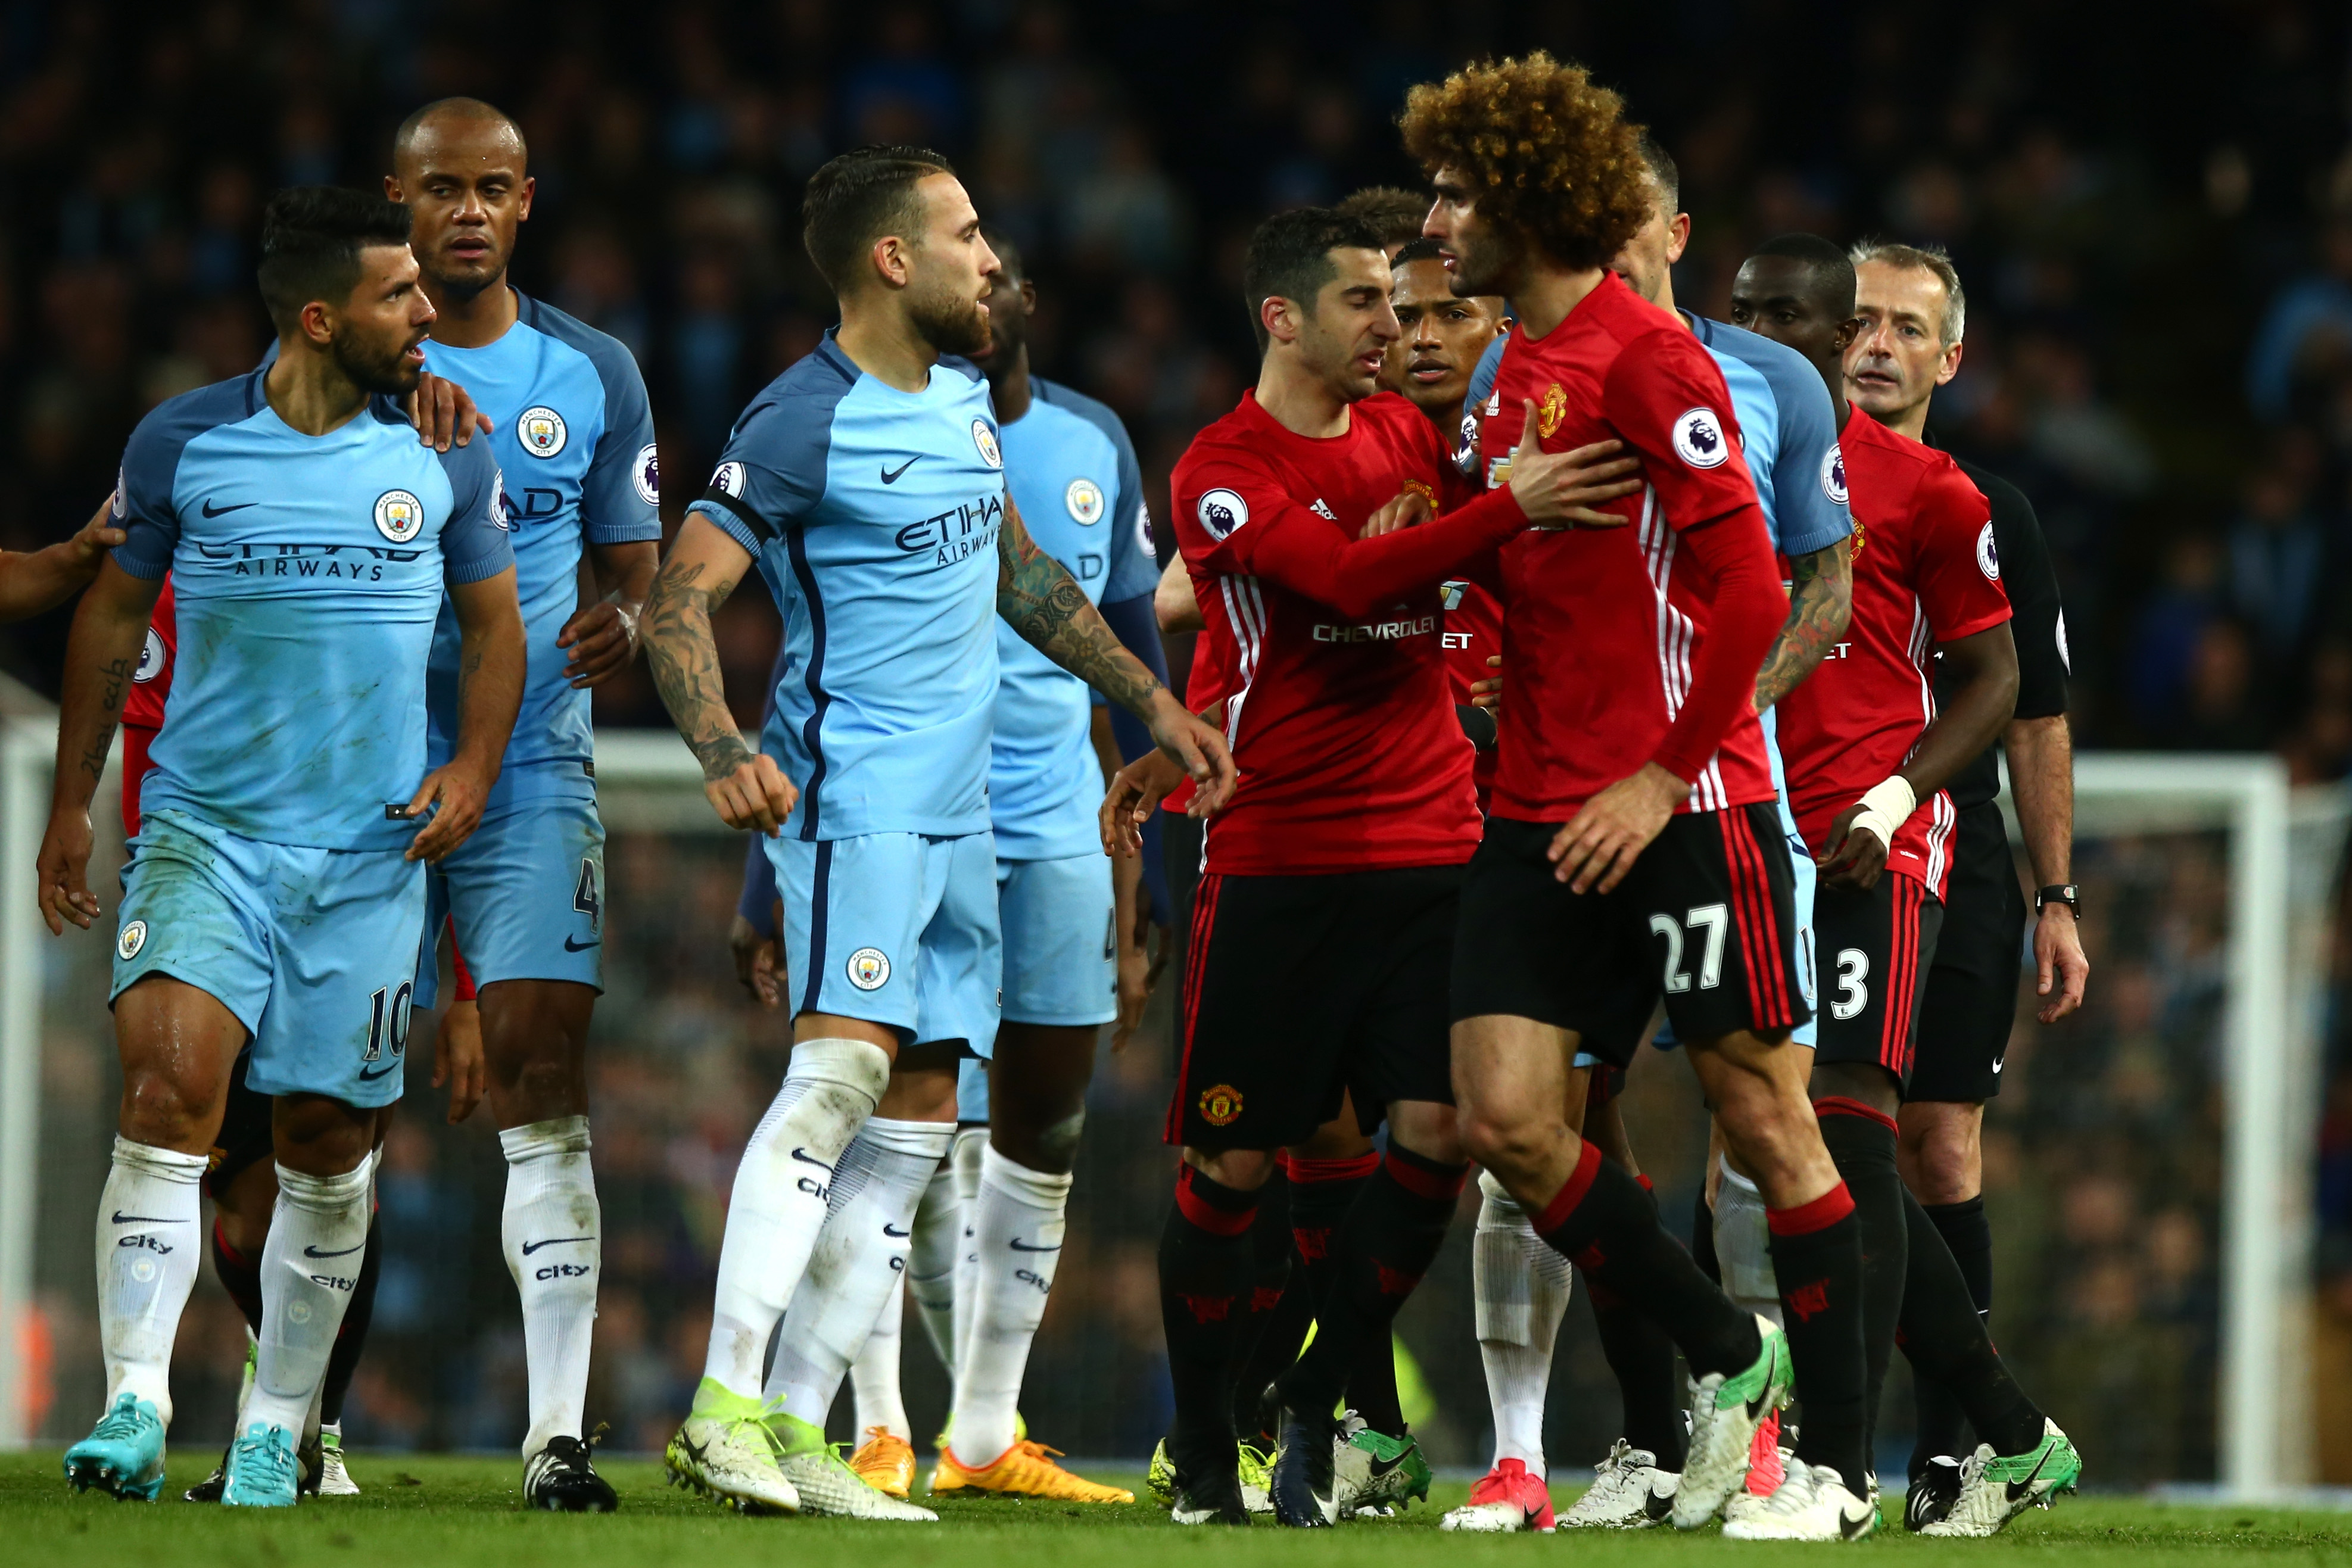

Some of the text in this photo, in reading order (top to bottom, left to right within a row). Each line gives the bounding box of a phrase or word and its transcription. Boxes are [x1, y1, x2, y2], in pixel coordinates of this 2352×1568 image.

[522, 410, 562, 426] MANCHESTER
[379, 494, 419, 510] MANCHESTER
[235, 559, 383, 581] AIRWAYS
[1313, 615, 1436, 643] CHEVROLET
[574, 858, 599, 935] 4
[1649, 904, 1728, 993] 27
[1830, 948, 1870, 1020] 3
[363, 980, 412, 1061] 10
